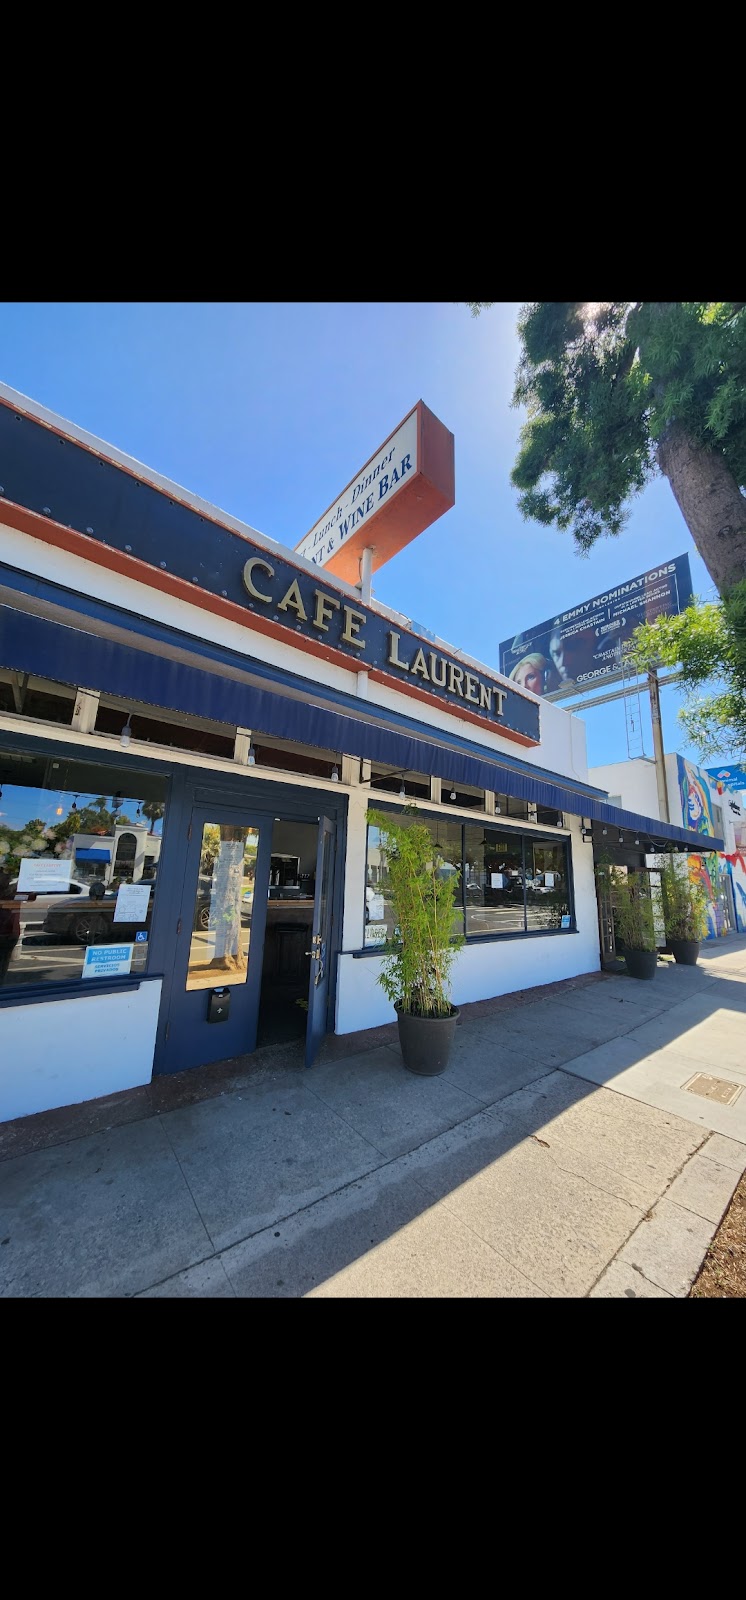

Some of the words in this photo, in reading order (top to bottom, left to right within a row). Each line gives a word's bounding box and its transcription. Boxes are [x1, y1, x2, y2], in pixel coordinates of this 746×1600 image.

[313, 506, 343, 547] Lunch
[351, 447, 396, 505] Dinner
[327, 537, 335, 554] &
[338, 492, 375, 540] WINE
[378, 453, 412, 501] BAR
[562, 603, 591, 622] EMMY
[592, 563, 677, 608] NOMINATIONS
[612, 604, 638, 617] MICHAEL
[640, 590, 671, 606] SHANNON
[243, 557, 366, 649] CAFE
[387, 631, 508, 717] LAURENT
[576, 665, 611, 682] GEORGE
